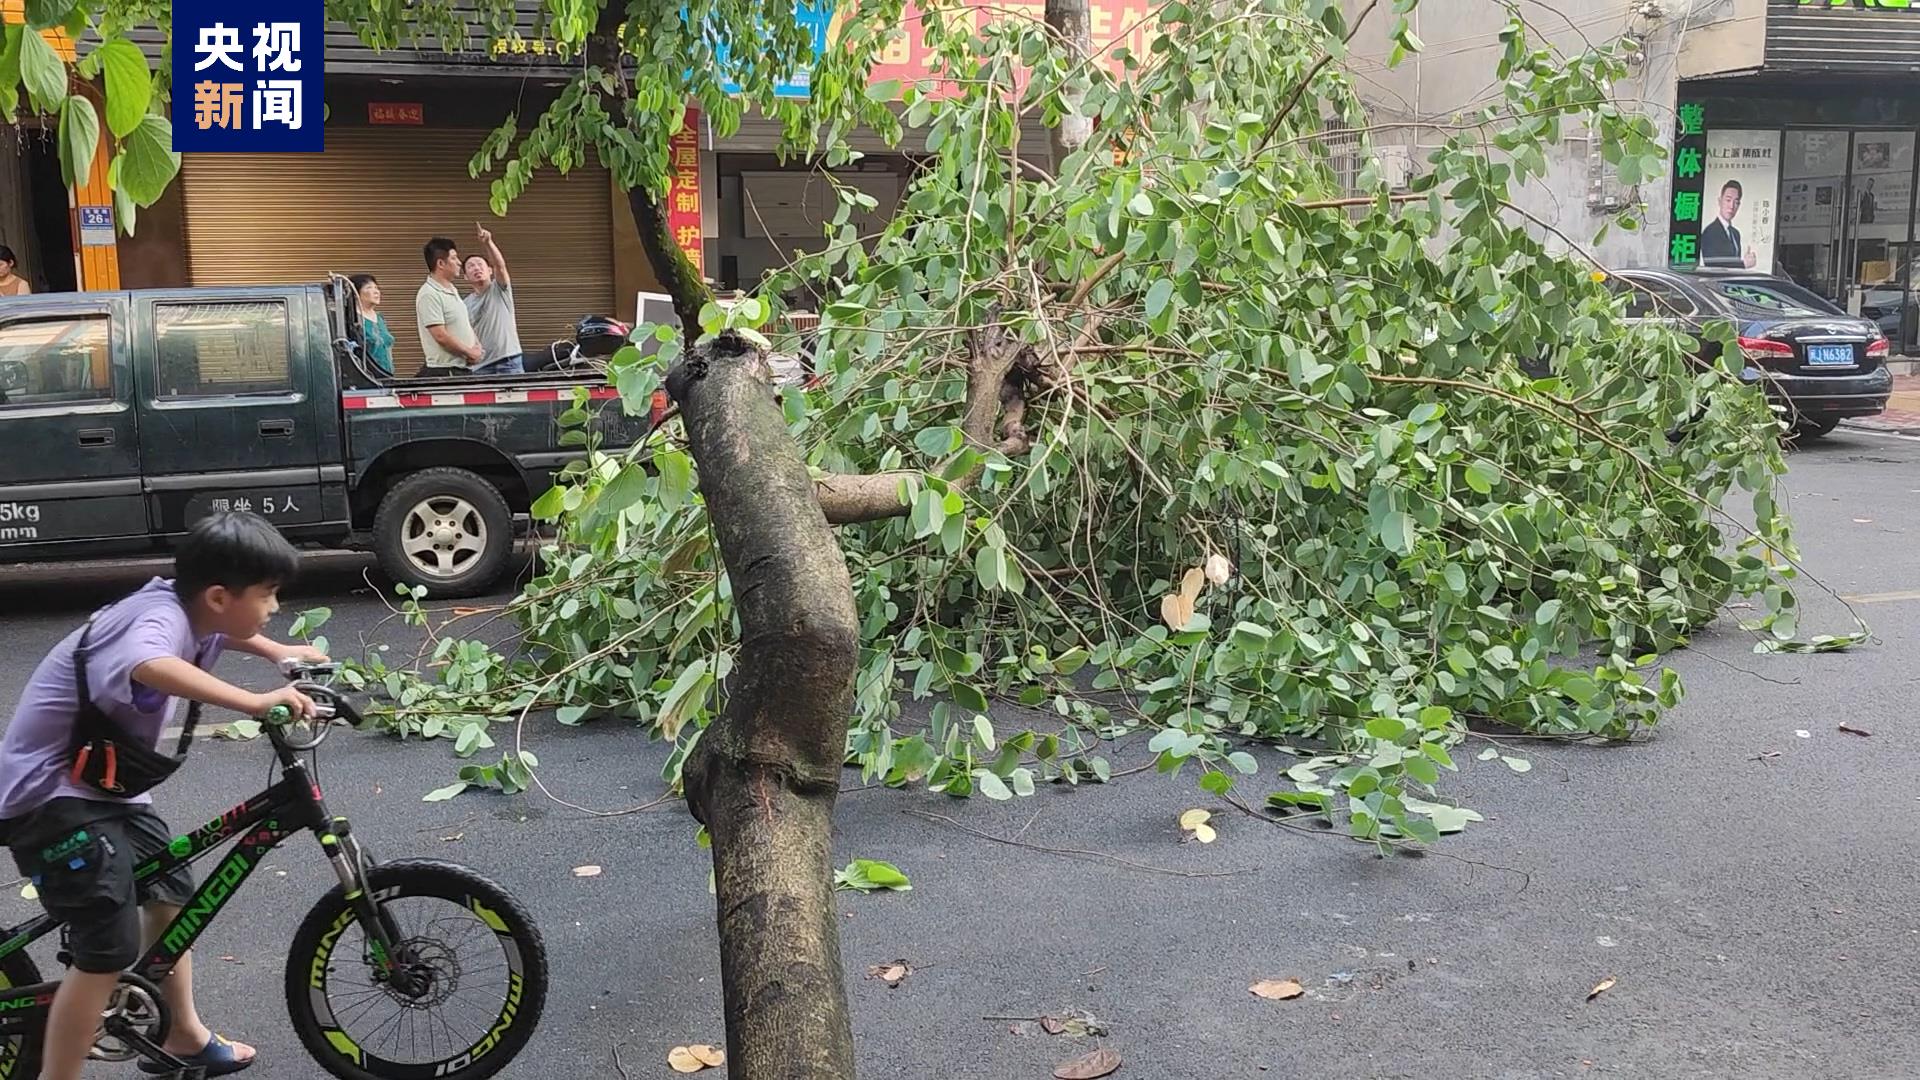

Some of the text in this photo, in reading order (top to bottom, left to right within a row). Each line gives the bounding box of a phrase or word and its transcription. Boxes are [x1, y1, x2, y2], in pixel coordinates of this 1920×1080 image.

[675, 124, 699, 213] 全屋定制
[1671, 103, 1704, 264] 整体橱柜
[88, 214, 104, 224] 26
